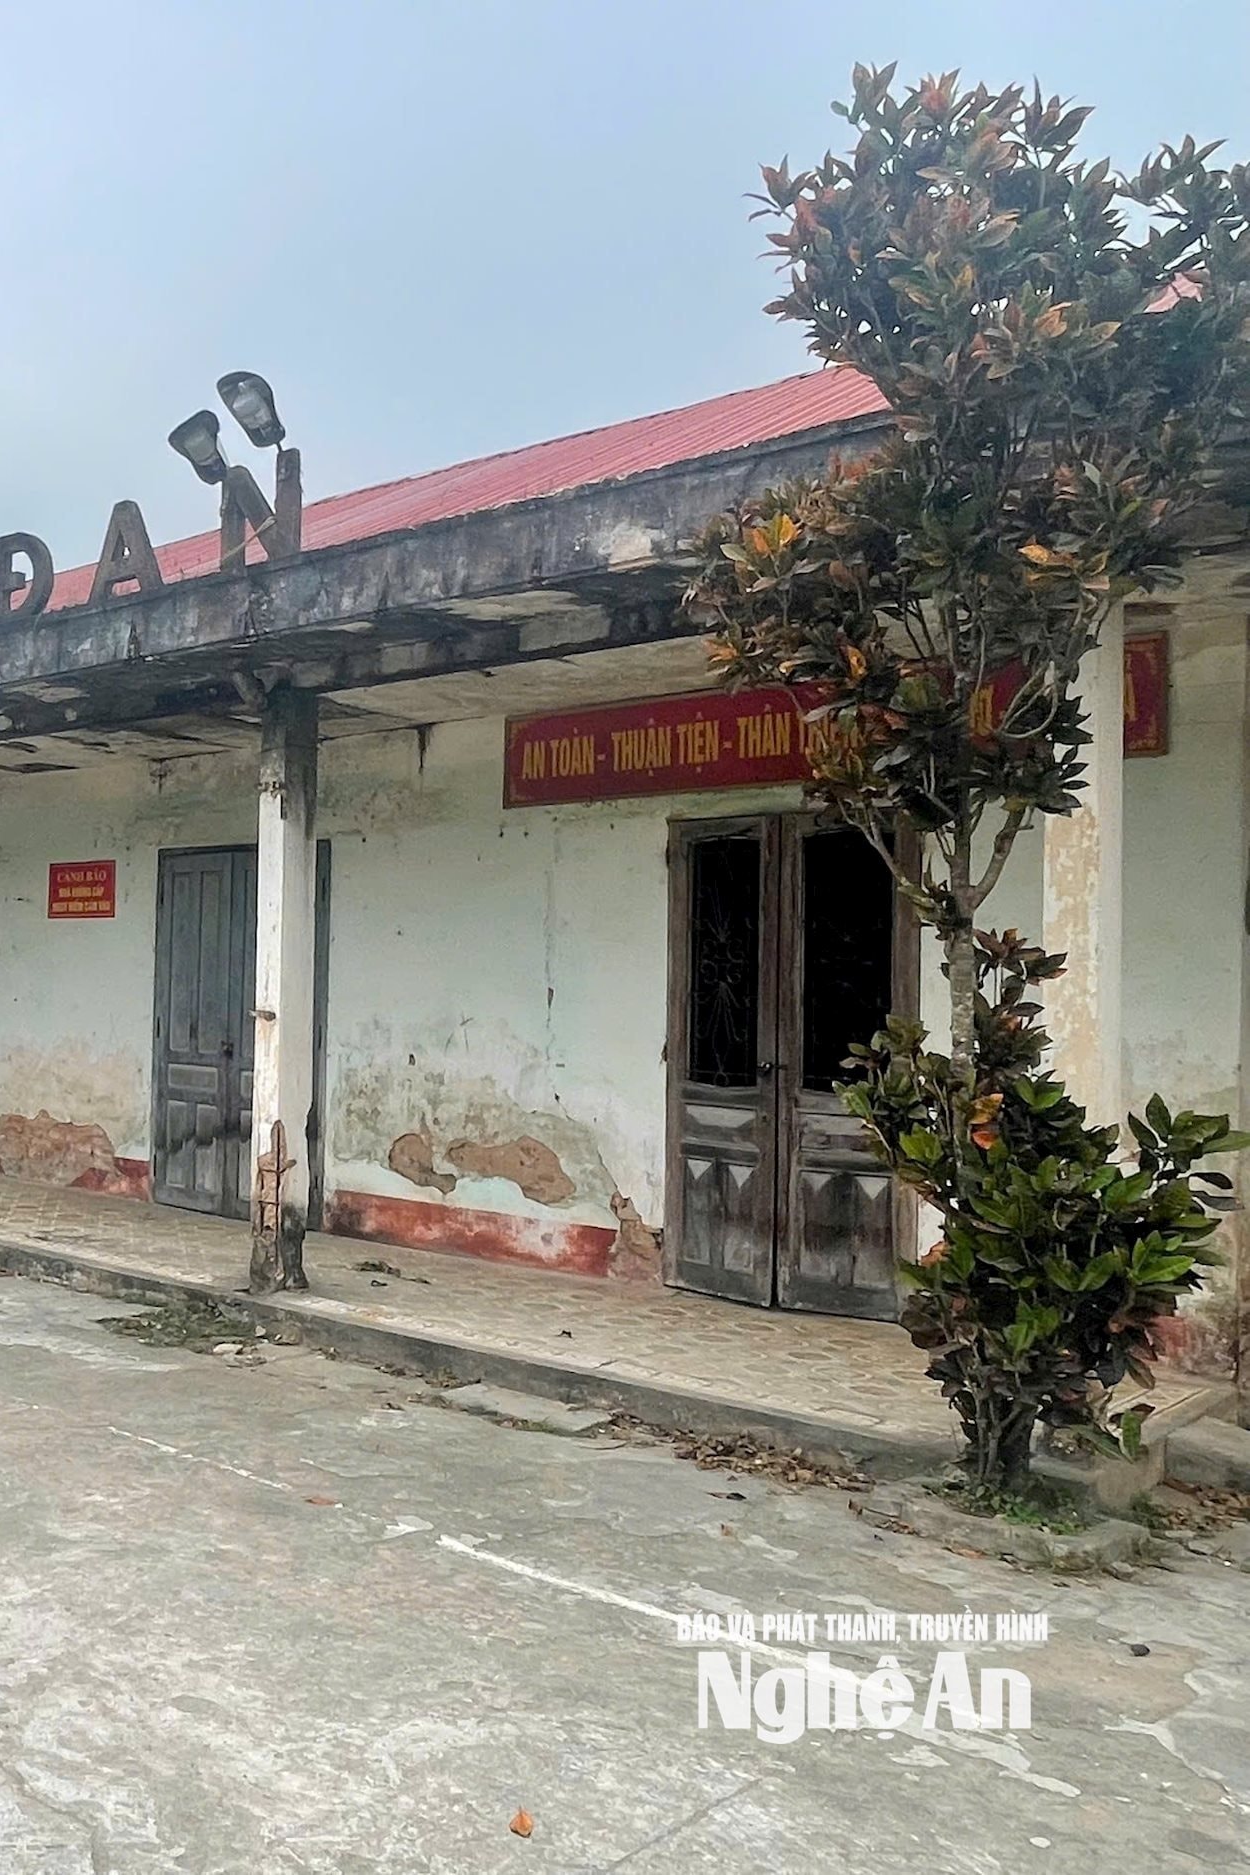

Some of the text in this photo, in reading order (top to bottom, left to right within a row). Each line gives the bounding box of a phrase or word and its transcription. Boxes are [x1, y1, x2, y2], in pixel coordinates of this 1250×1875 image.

[522, 741, 545, 780] AN
[549, 727, 595, 777] TOÀN
[611, 717, 671, 777] THUẬN
[676, 711, 719, 774] TIỆN
[736, 703, 791, 760] THÂN
